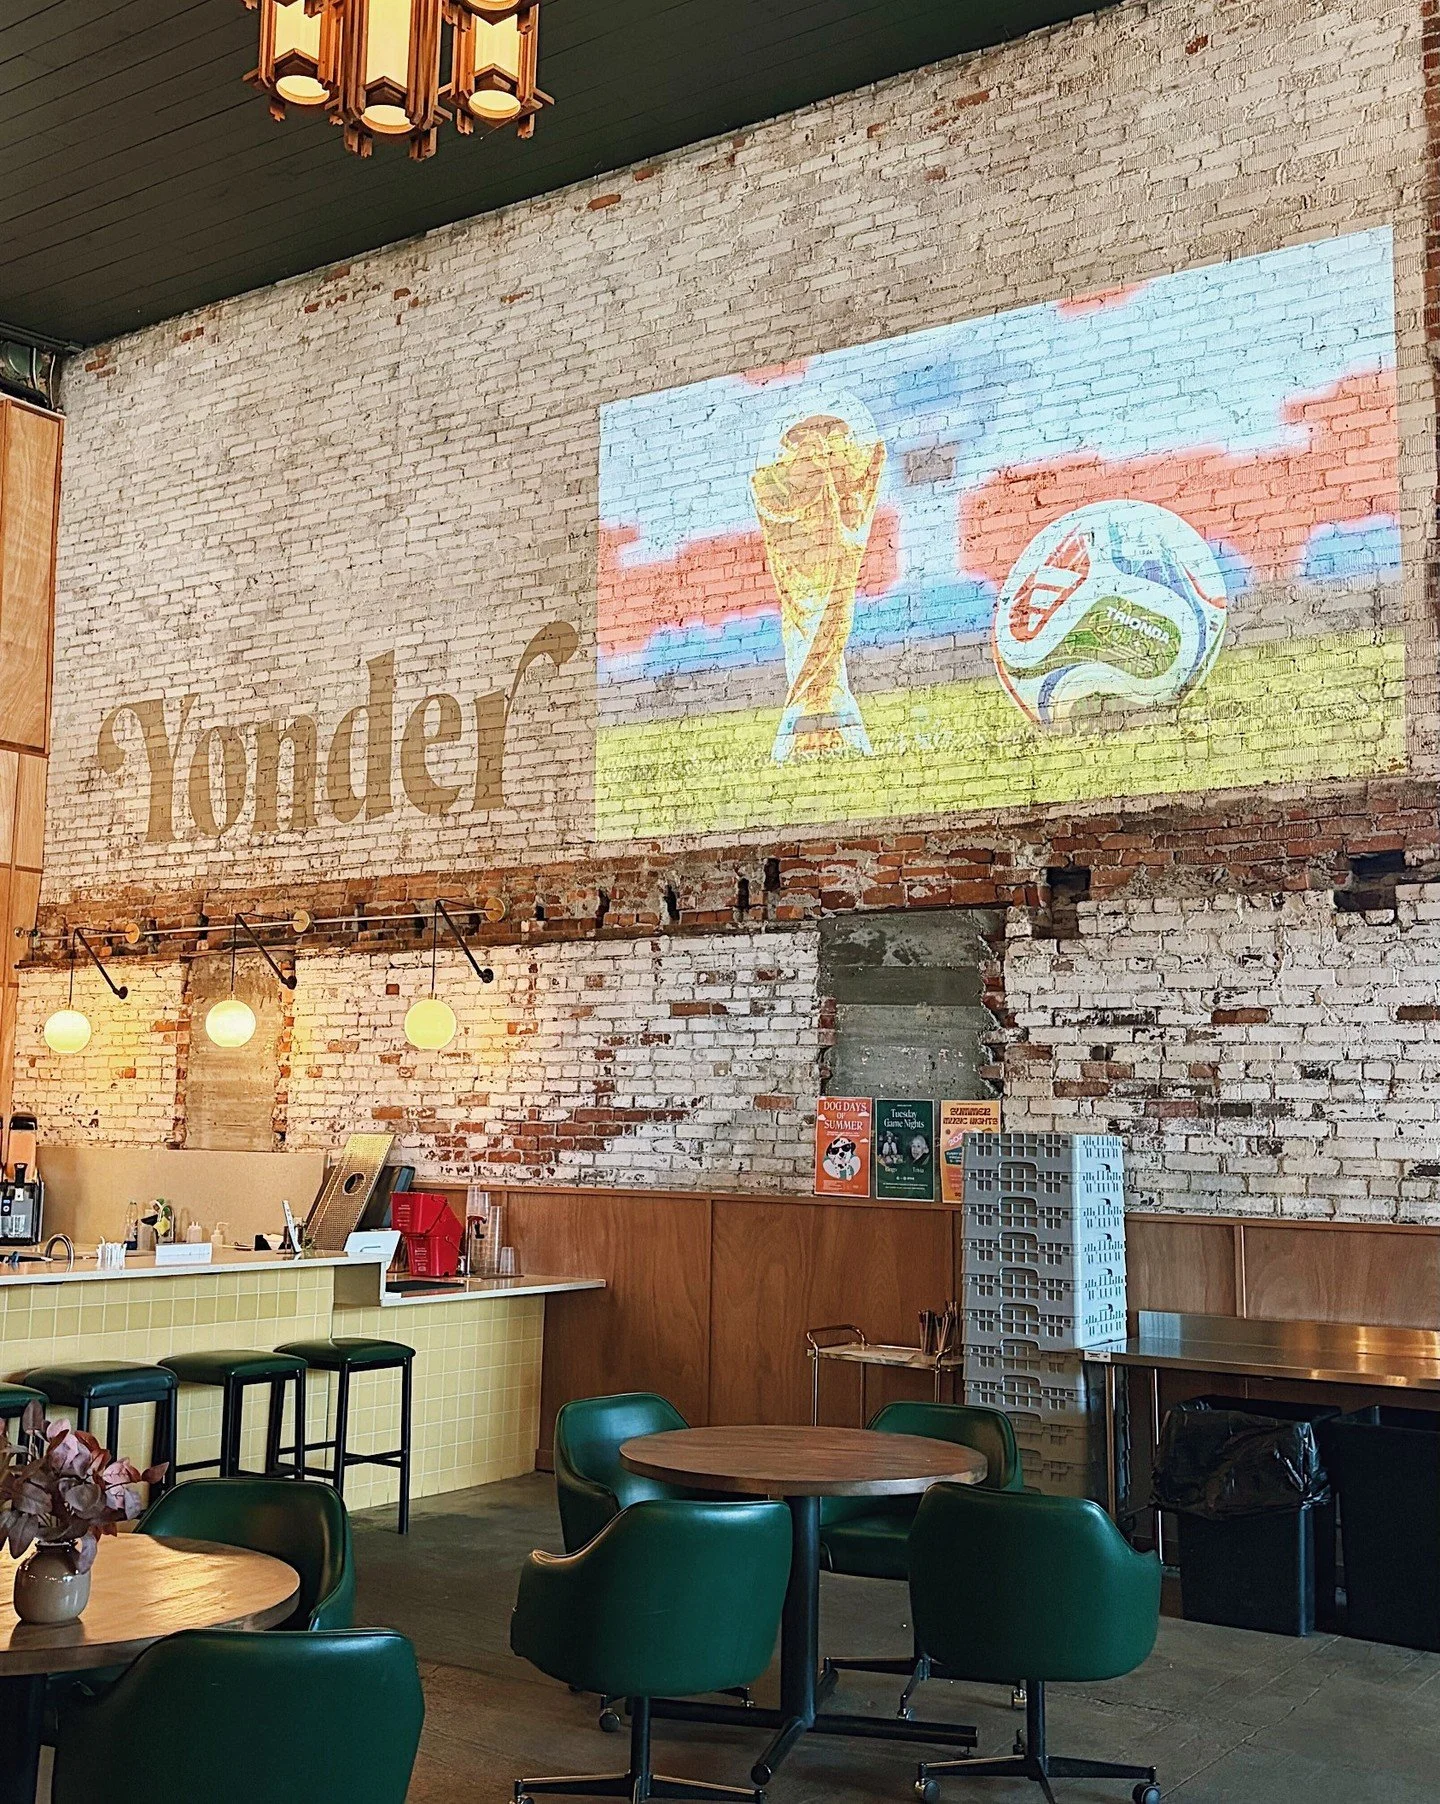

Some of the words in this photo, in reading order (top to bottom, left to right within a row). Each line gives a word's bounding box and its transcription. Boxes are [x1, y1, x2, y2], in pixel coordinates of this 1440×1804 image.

[1106, 605, 1170, 645] TRIONDA
[96, 621, 580, 844] Yonder
[823, 1101, 842, 1111] DOG
[843, 1102, 867, 1112] DAYS
[950, 1107, 991, 1116] SUMMER
[836, 1112, 846, 1120] OF
[890, 1108, 918, 1119] Tuesday
[824, 1120, 863, 1130] SUMMER
[883, 1118, 904, 1128] Game
[904, 1118, 925, 1130] Nights
[943, 1117, 968, 1125] MUSIC
[969, 1117, 999, 1125] NIGHTS
